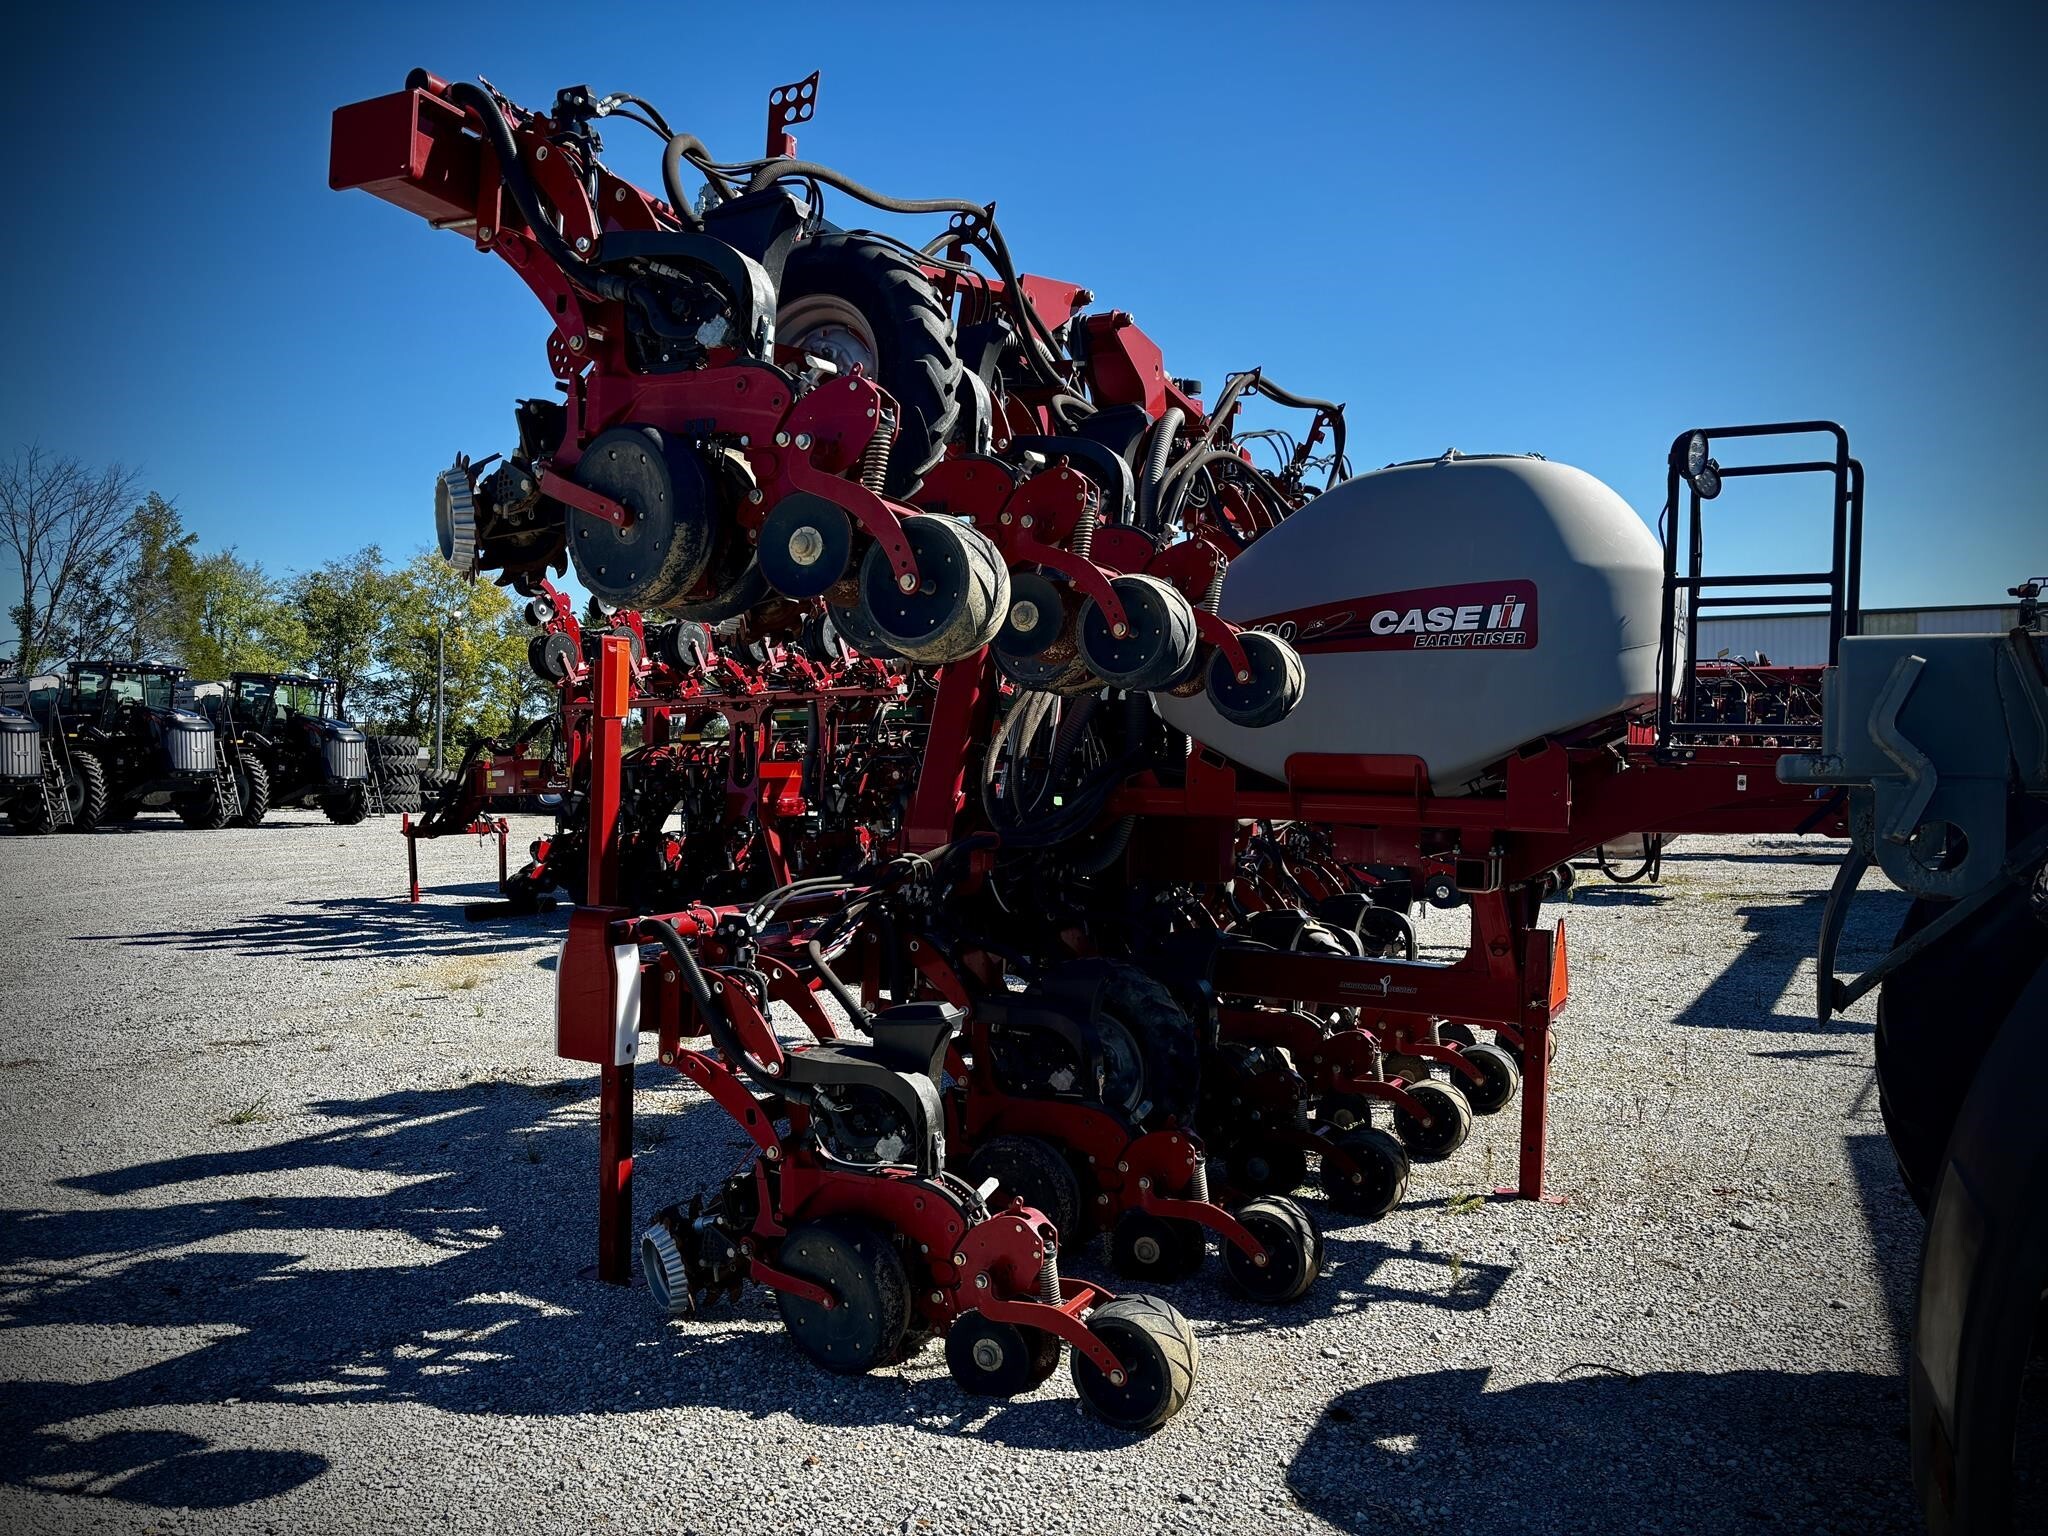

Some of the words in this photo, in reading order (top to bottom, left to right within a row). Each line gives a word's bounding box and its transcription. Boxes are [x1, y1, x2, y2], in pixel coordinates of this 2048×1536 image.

[1369, 604, 1484, 636] CASE
[1413, 632, 1472, 648] EARLY
[1471, 631, 1527, 646] RISER
